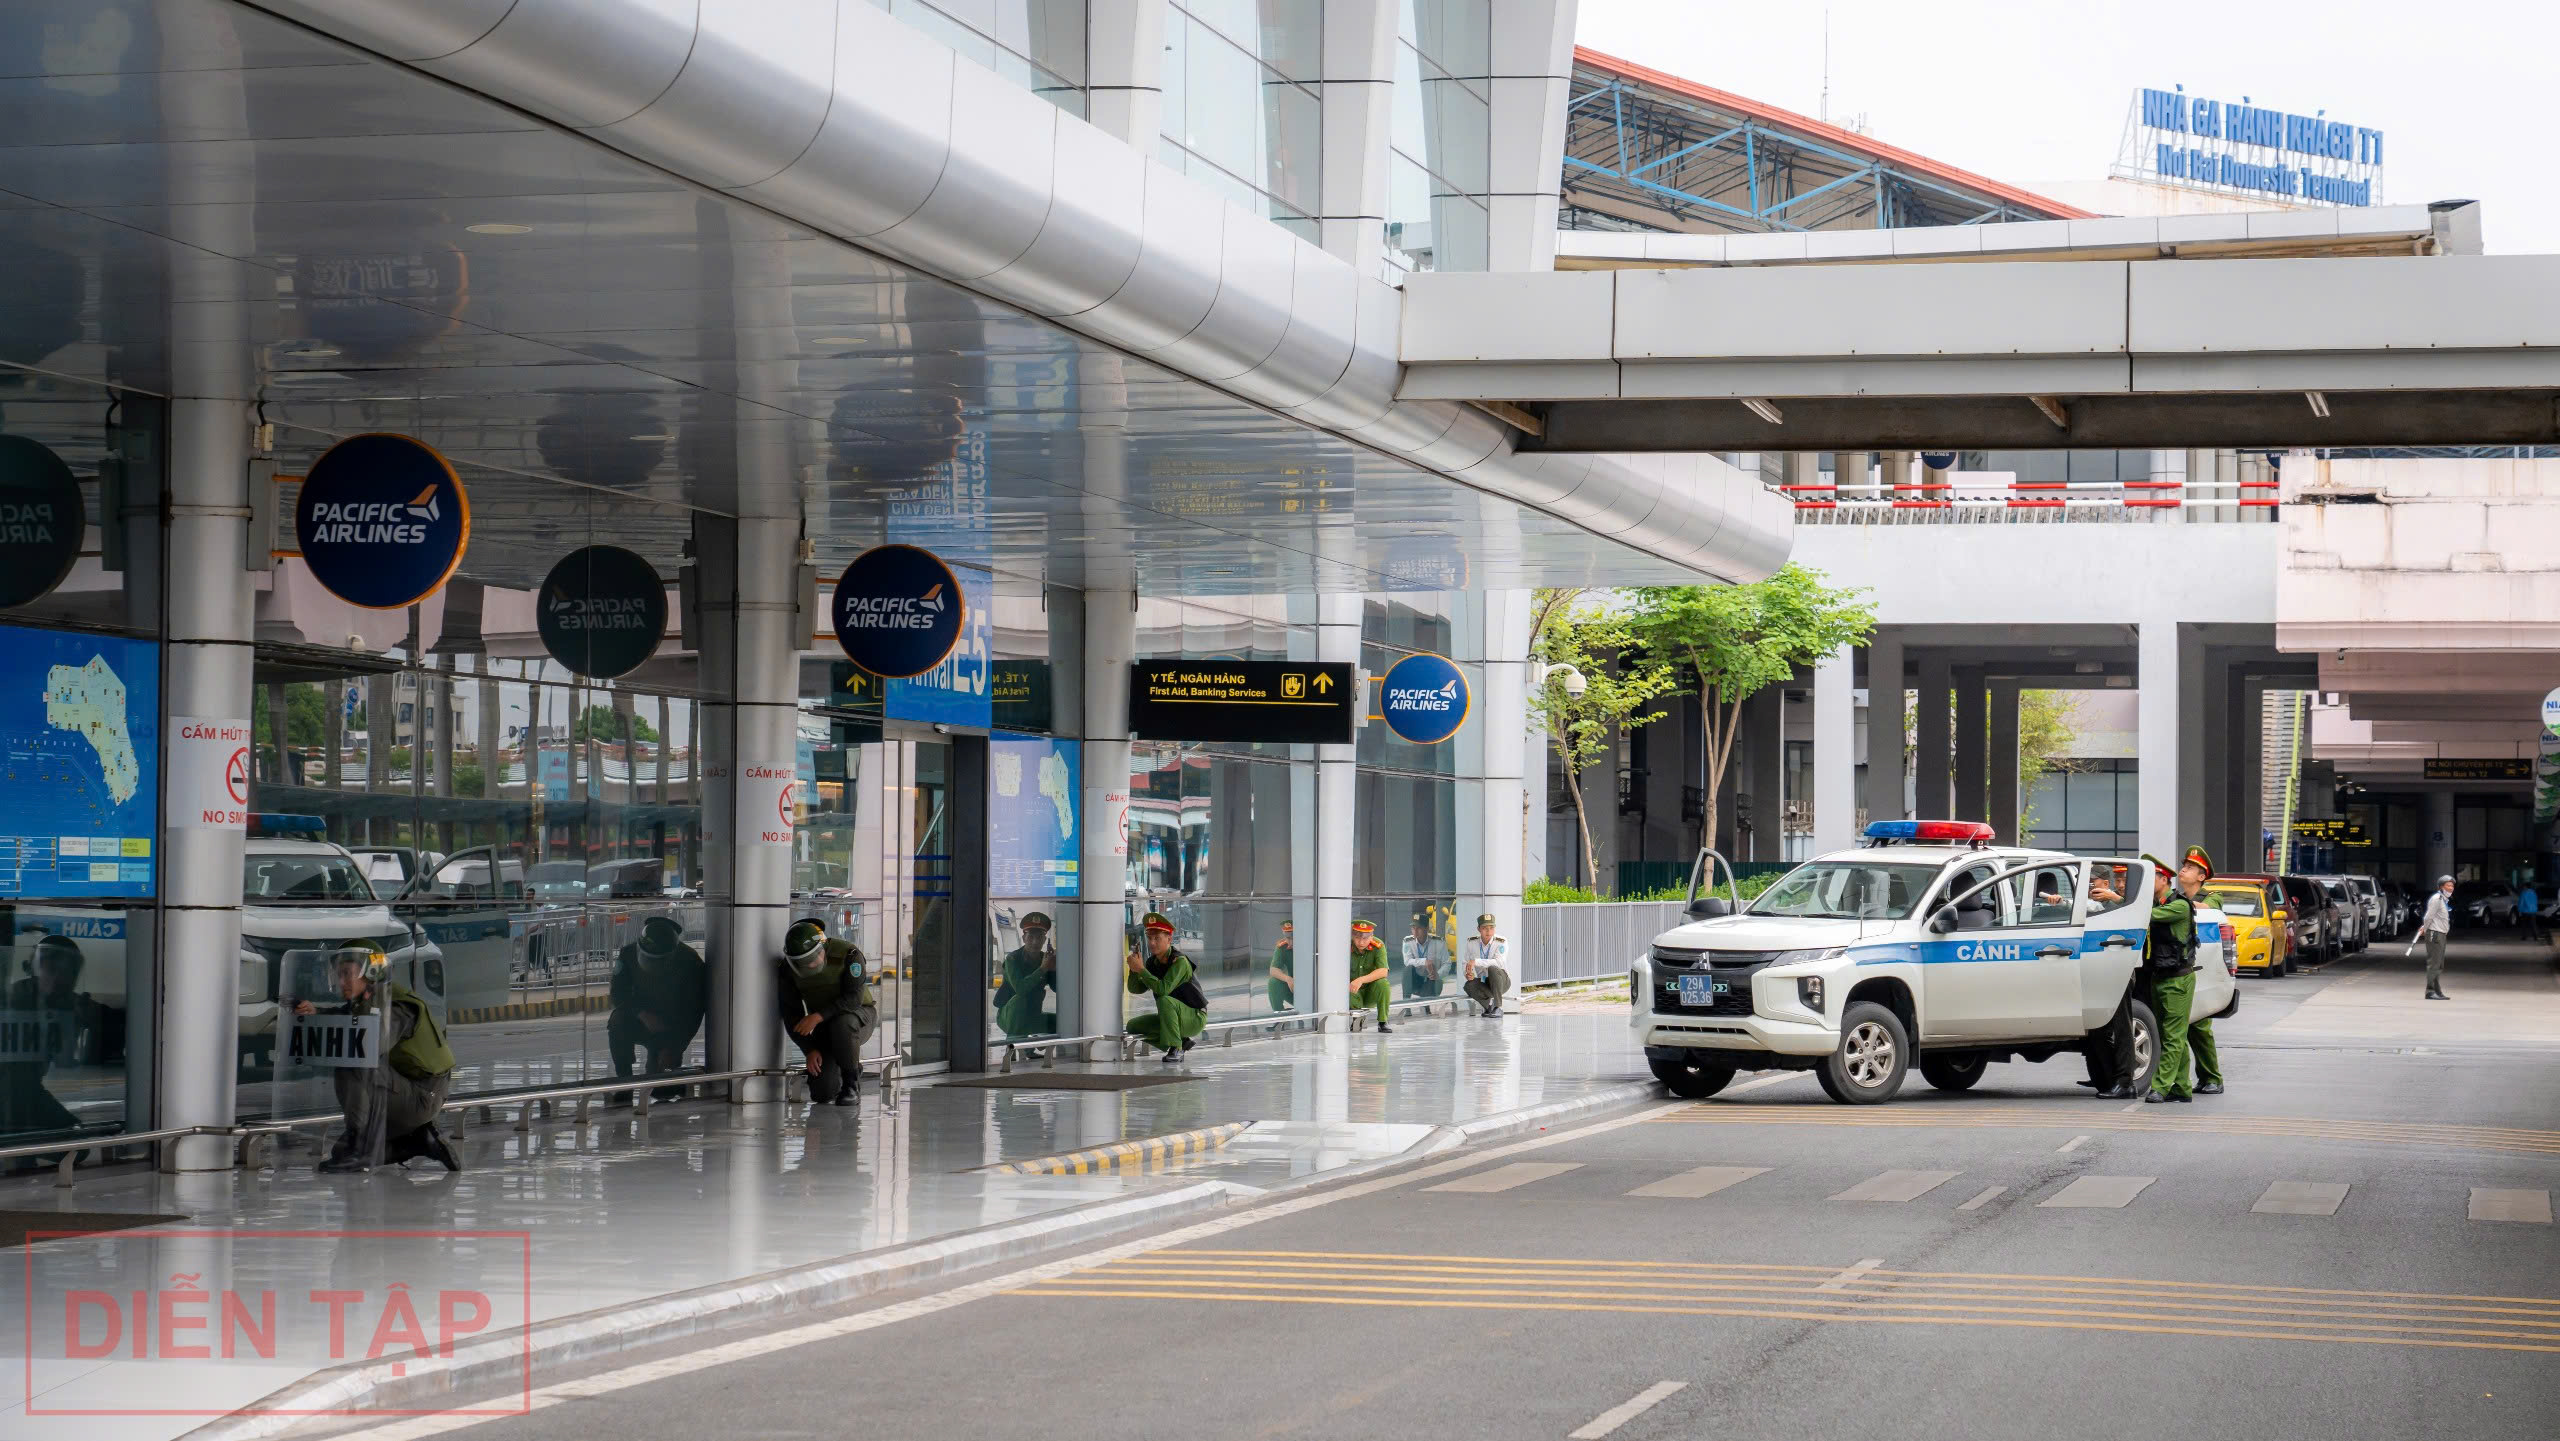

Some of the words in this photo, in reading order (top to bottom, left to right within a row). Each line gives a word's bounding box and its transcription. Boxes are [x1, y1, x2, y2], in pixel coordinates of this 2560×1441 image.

[2143, 83, 2189, 134] NHÀ
[2192, 98, 2222, 139] GA
[2225, 95, 2285, 149] HÀNH
[2286, 110, 2354, 161] KHÁCH
[2358, 127, 2384, 166] T1
[2221, 154, 2299, 196] Domestic
[2300, 167, 2371, 207] Terminal
[312, 503, 404, 522] PACIFIC
[313, 524, 427, 543] AIRLINES
[845, 597, 918, 613] PACIFIC
[846, 613, 934, 629] AIRLINES
[1151, 673, 1158, 682] Y
[1161, 671, 1177, 684] TẾ,
[1180, 672, 1211, 684] NGÂN
[1214, 672, 1246, 684] HÀNG
[1149, 686, 1170, 696] First
[1171, 687, 1189, 697] Aid,
[1190, 687, 1227, 699] Banking
[1228, 688, 1267, 698] Services
[1390, 688, 1439, 700] PACIFIC
[1390, 699, 1450, 711] AIRLINES
[2546, 701, 2560, 709] NI
[182, 723, 216, 740] CẤM
[221, 726, 243, 741] HÚT
[746, 766, 772, 779] CẤM
[203, 810, 225, 824] NO
[762, 831, 779, 842] NO
[1956, 938, 2020, 960] CẢNH
[1686, 977, 1704, 990] 29A
[1681, 991, 1712, 1003] 025.36
[289, 1025, 368, 1058] ANHK
